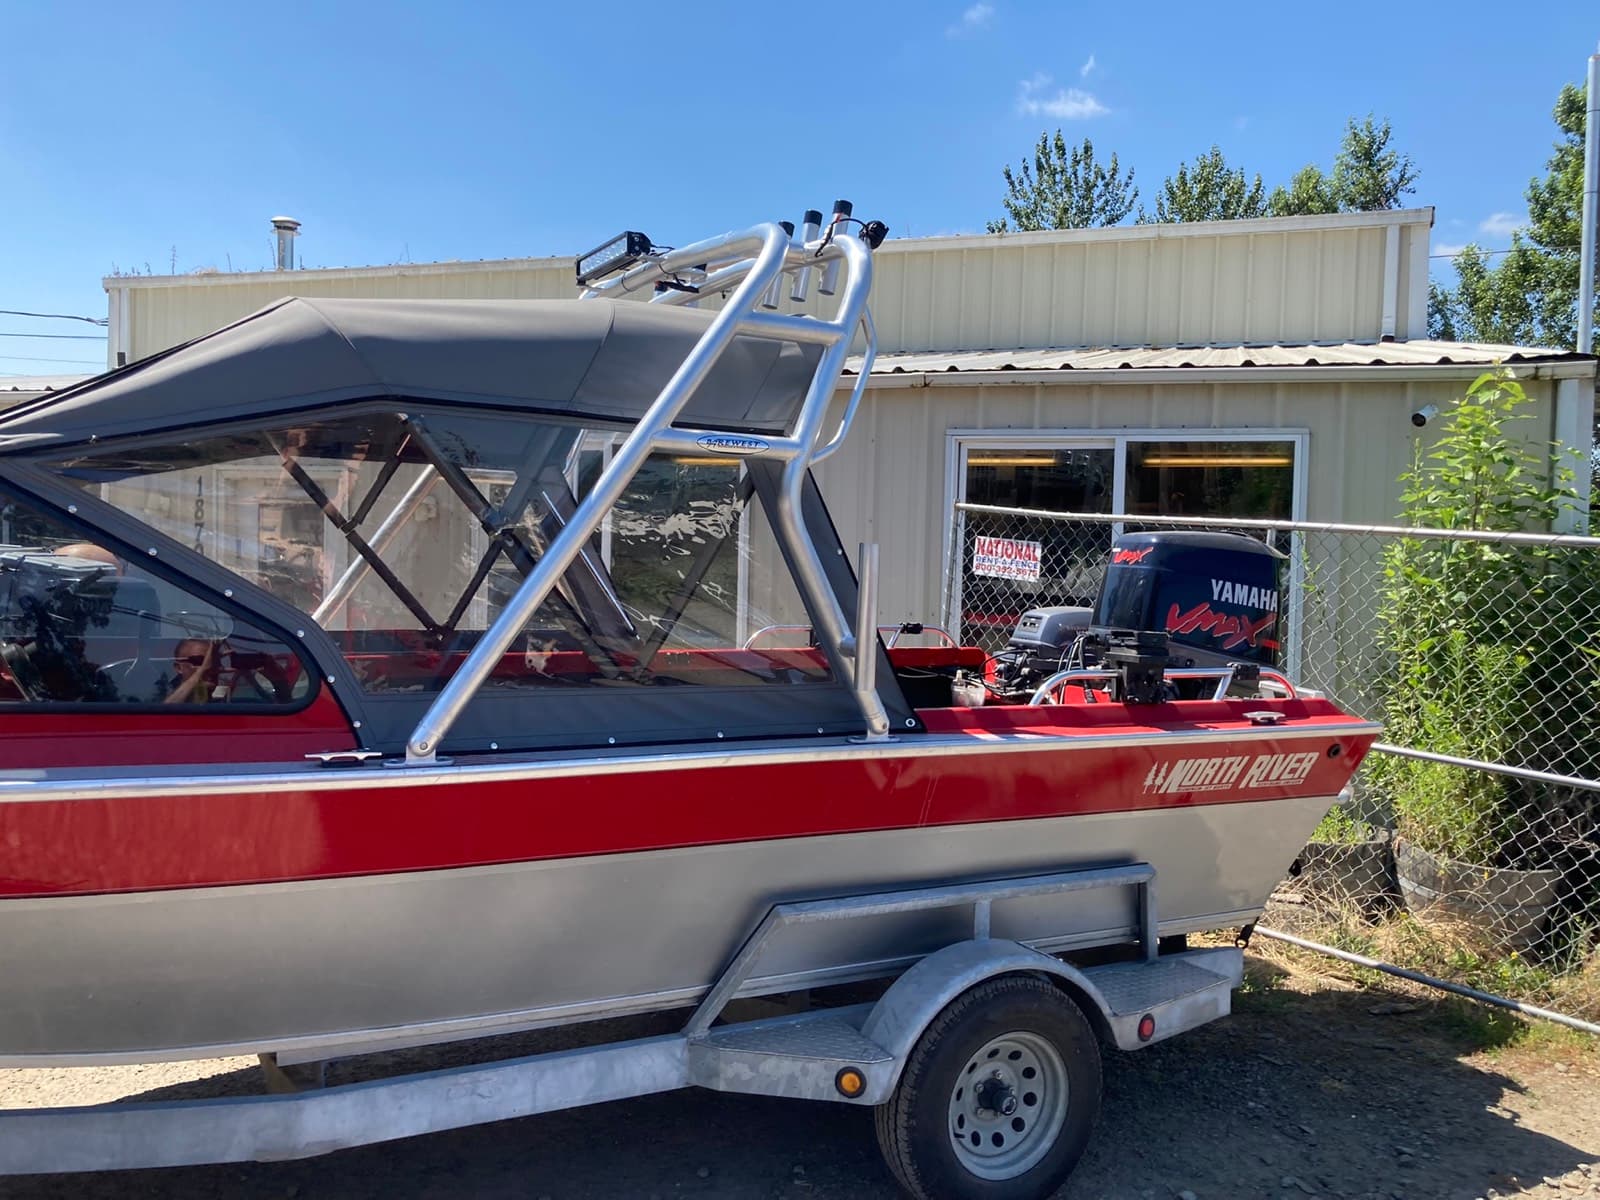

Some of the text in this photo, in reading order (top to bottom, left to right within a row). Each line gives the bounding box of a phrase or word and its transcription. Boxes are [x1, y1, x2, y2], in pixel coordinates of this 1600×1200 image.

[975, 555, 1039, 569] RENT-A-FENCE
[976, 537, 1039, 562] NATIONAL
[1211, 579, 1279, 612] YAMAHA
[1158, 752, 1320, 794] NORTH RIVER
